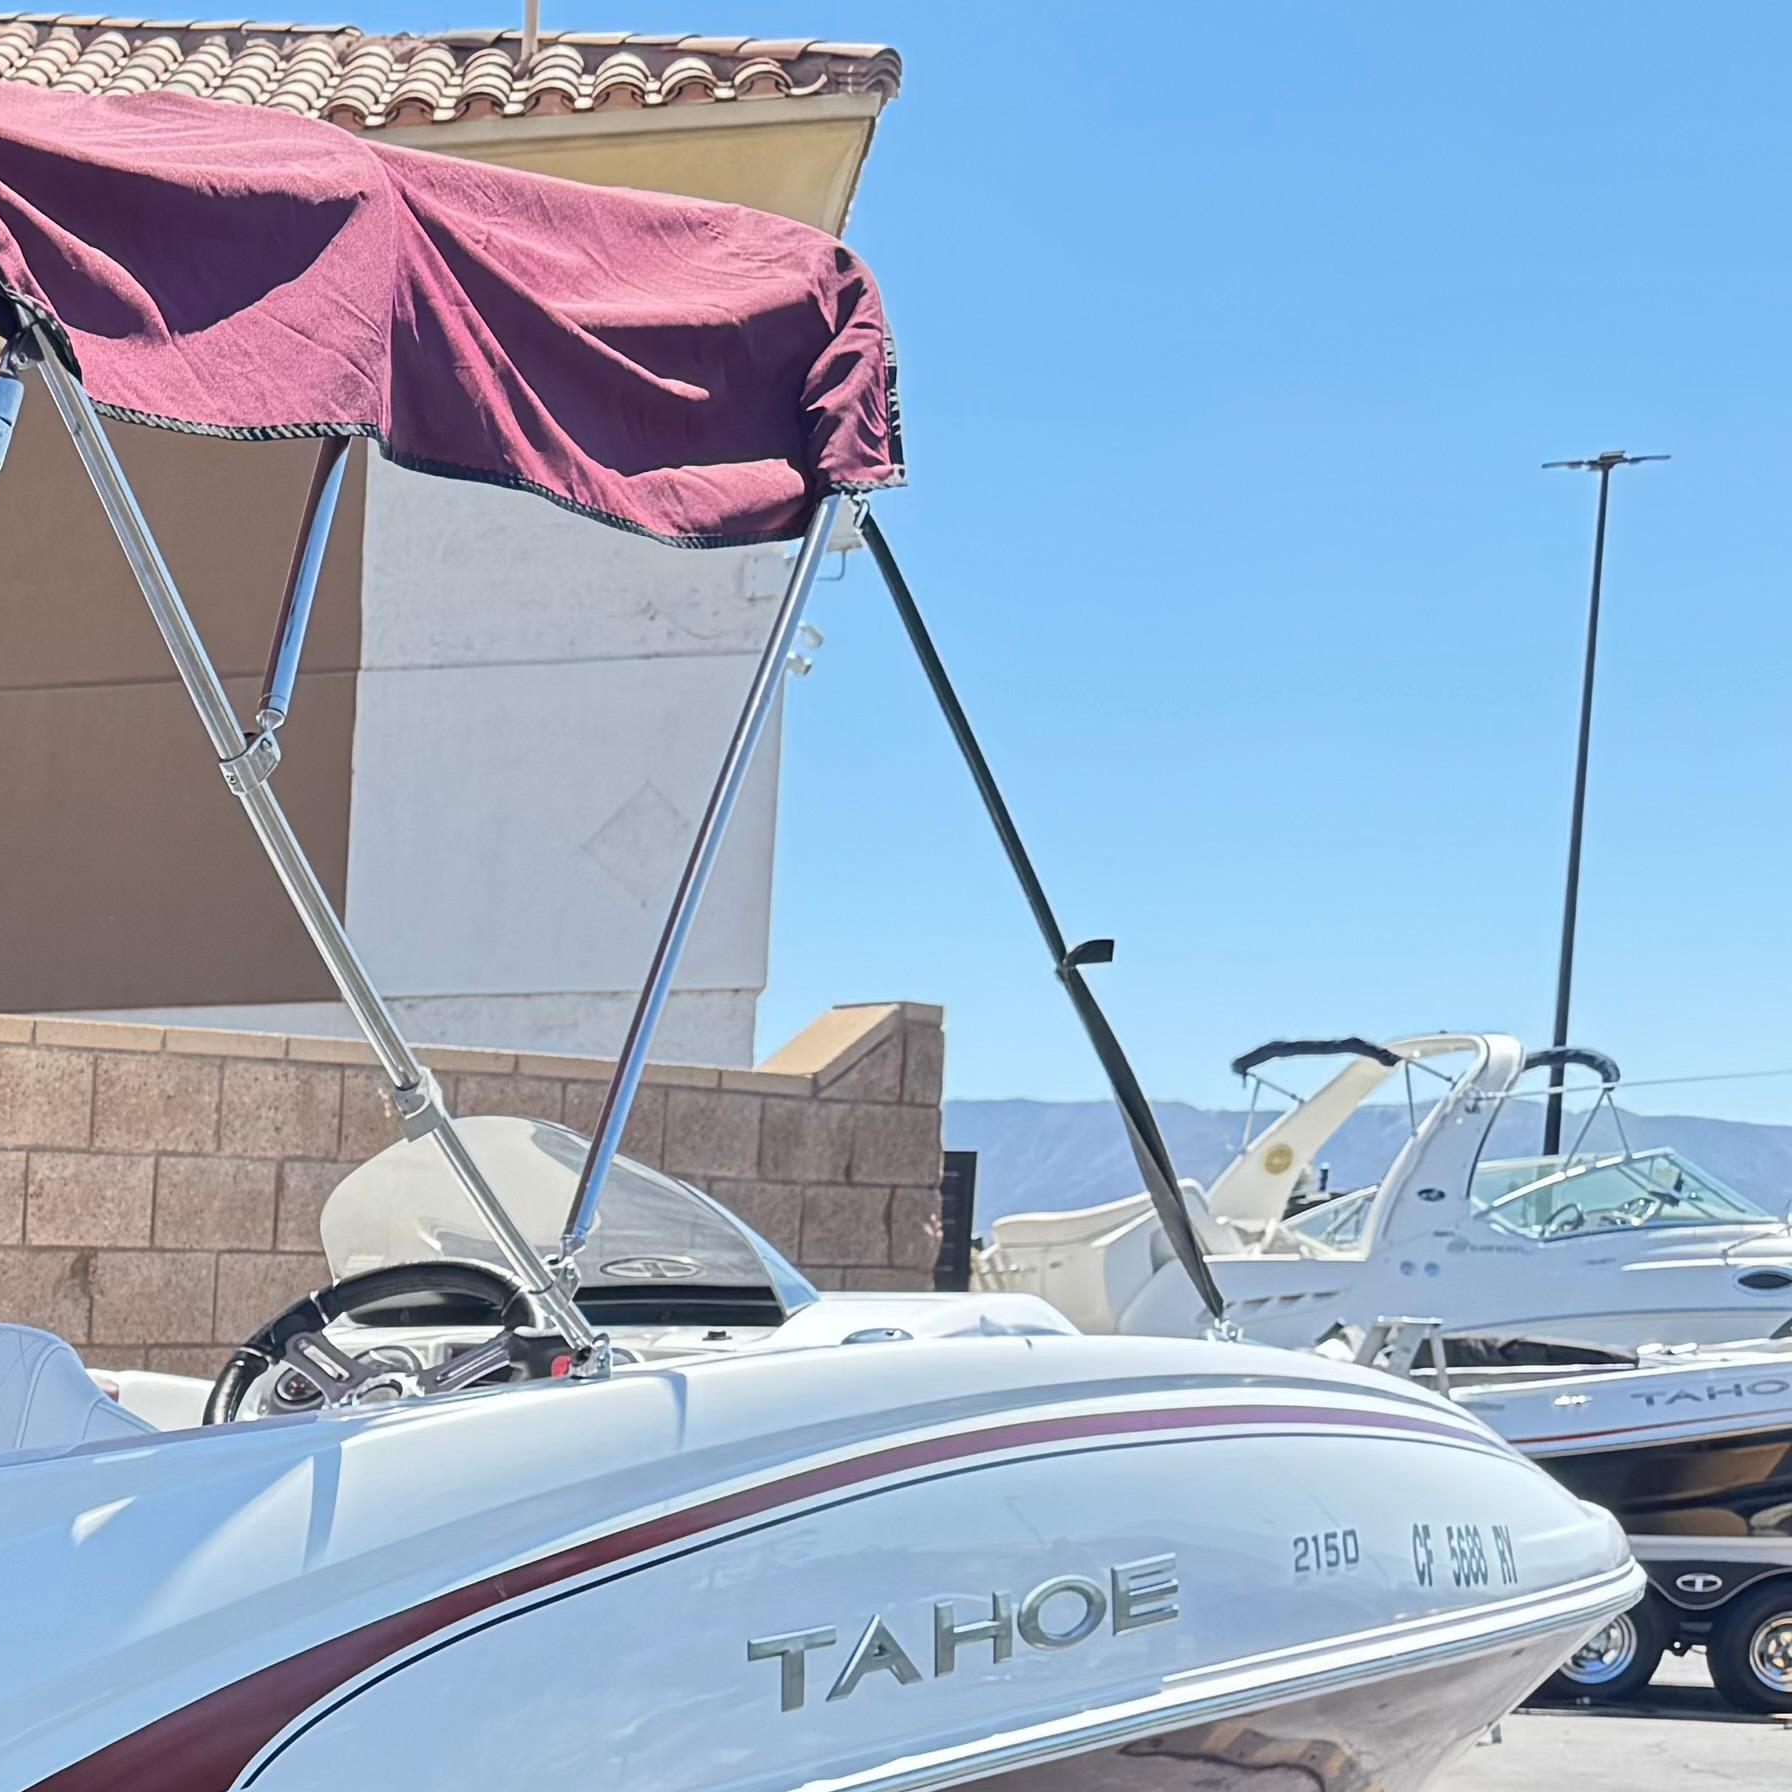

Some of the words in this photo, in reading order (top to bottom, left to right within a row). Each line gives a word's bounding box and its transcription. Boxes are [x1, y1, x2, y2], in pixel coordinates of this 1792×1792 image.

[1293, 1528, 1360, 1572] 2150
[1412, 1523, 1434, 1588] CF
[747, 1552, 1180, 1712] TAHOE
